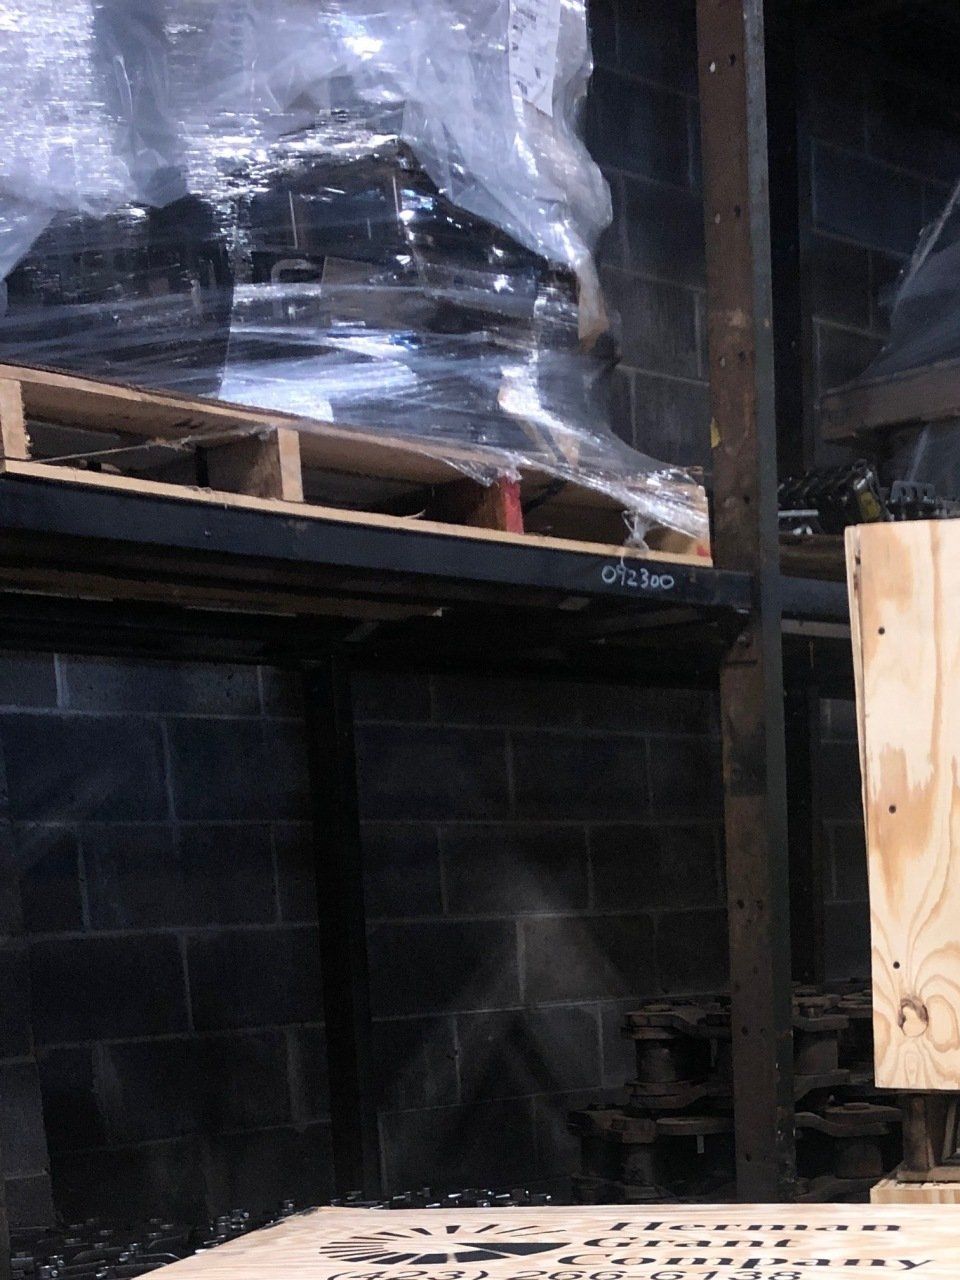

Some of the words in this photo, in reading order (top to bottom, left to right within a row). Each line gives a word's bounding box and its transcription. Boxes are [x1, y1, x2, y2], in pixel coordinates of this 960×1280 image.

[604, 1222, 902, 1232] Herman
[582, 1237, 794, 1249] Grant
[556, 1254, 936, 1271] Company
